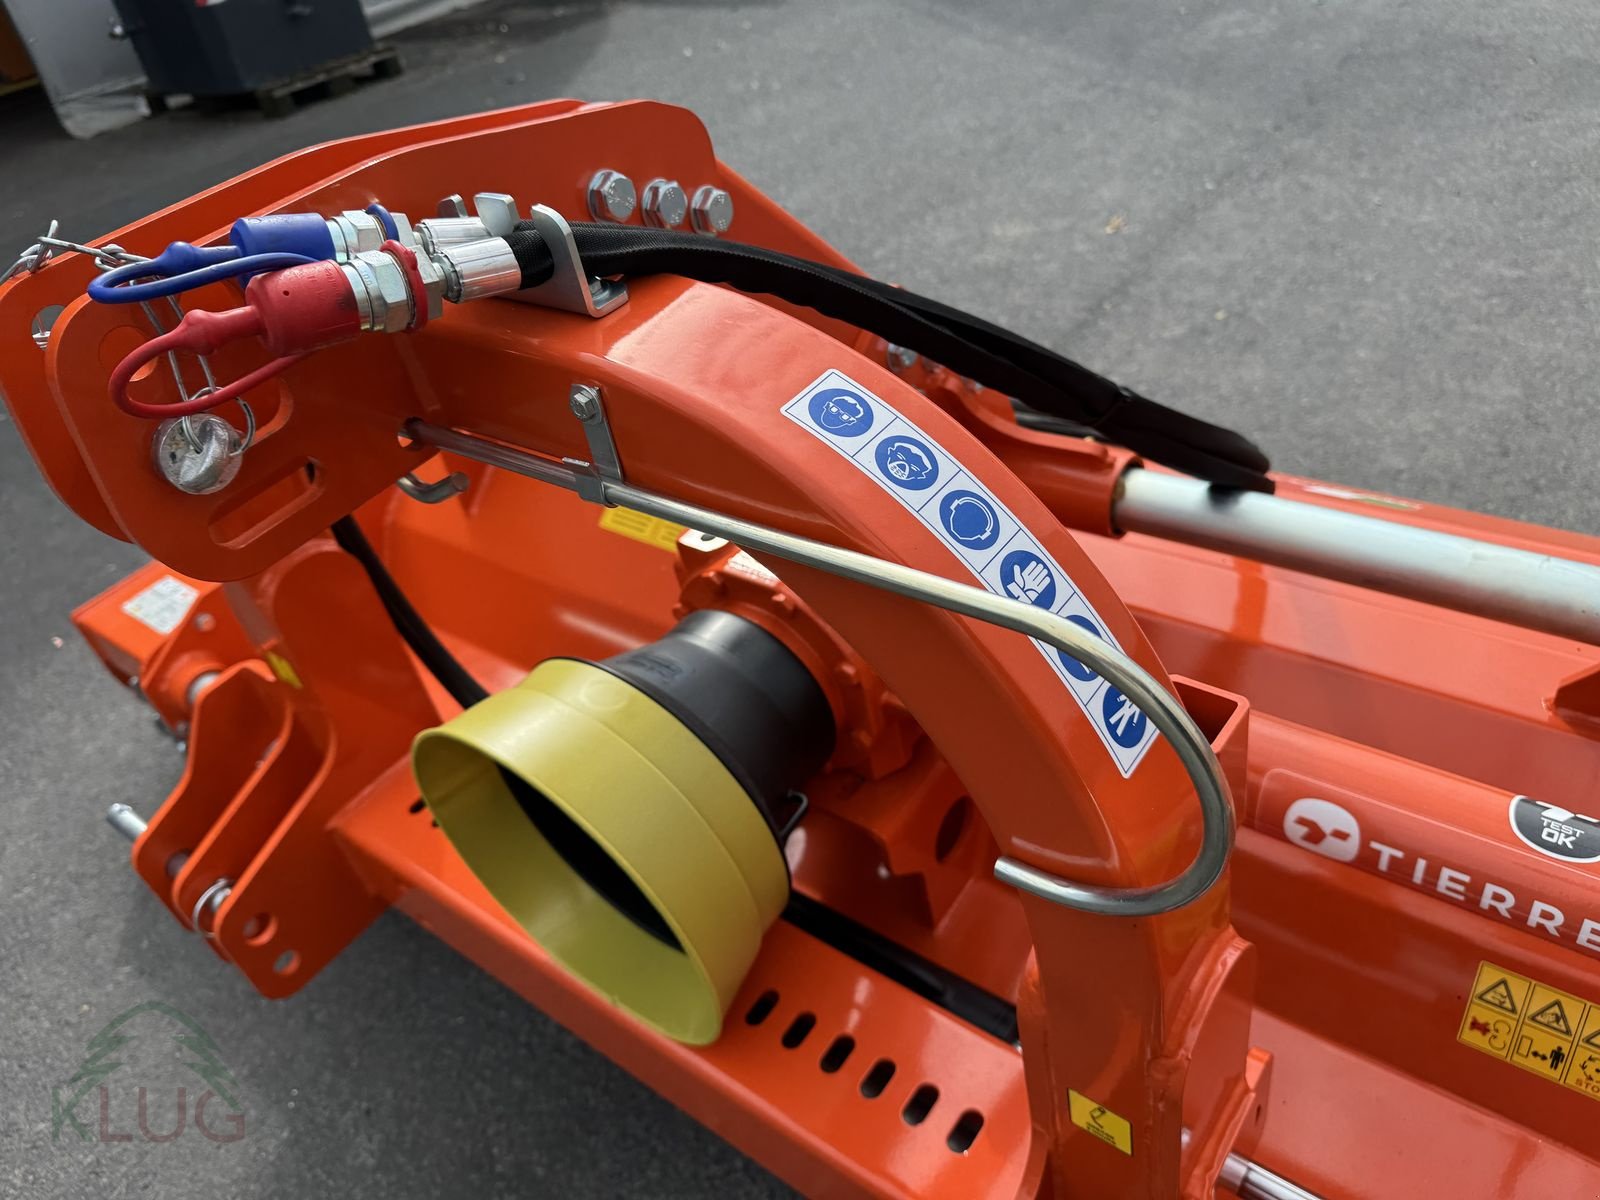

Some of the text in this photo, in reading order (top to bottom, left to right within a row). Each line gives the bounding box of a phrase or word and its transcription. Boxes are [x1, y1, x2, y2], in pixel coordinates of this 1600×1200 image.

[1541, 816, 1585, 838] TEST
[1541, 827, 1576, 849] OK
[1369, 840, 1600, 952] TIERRE
